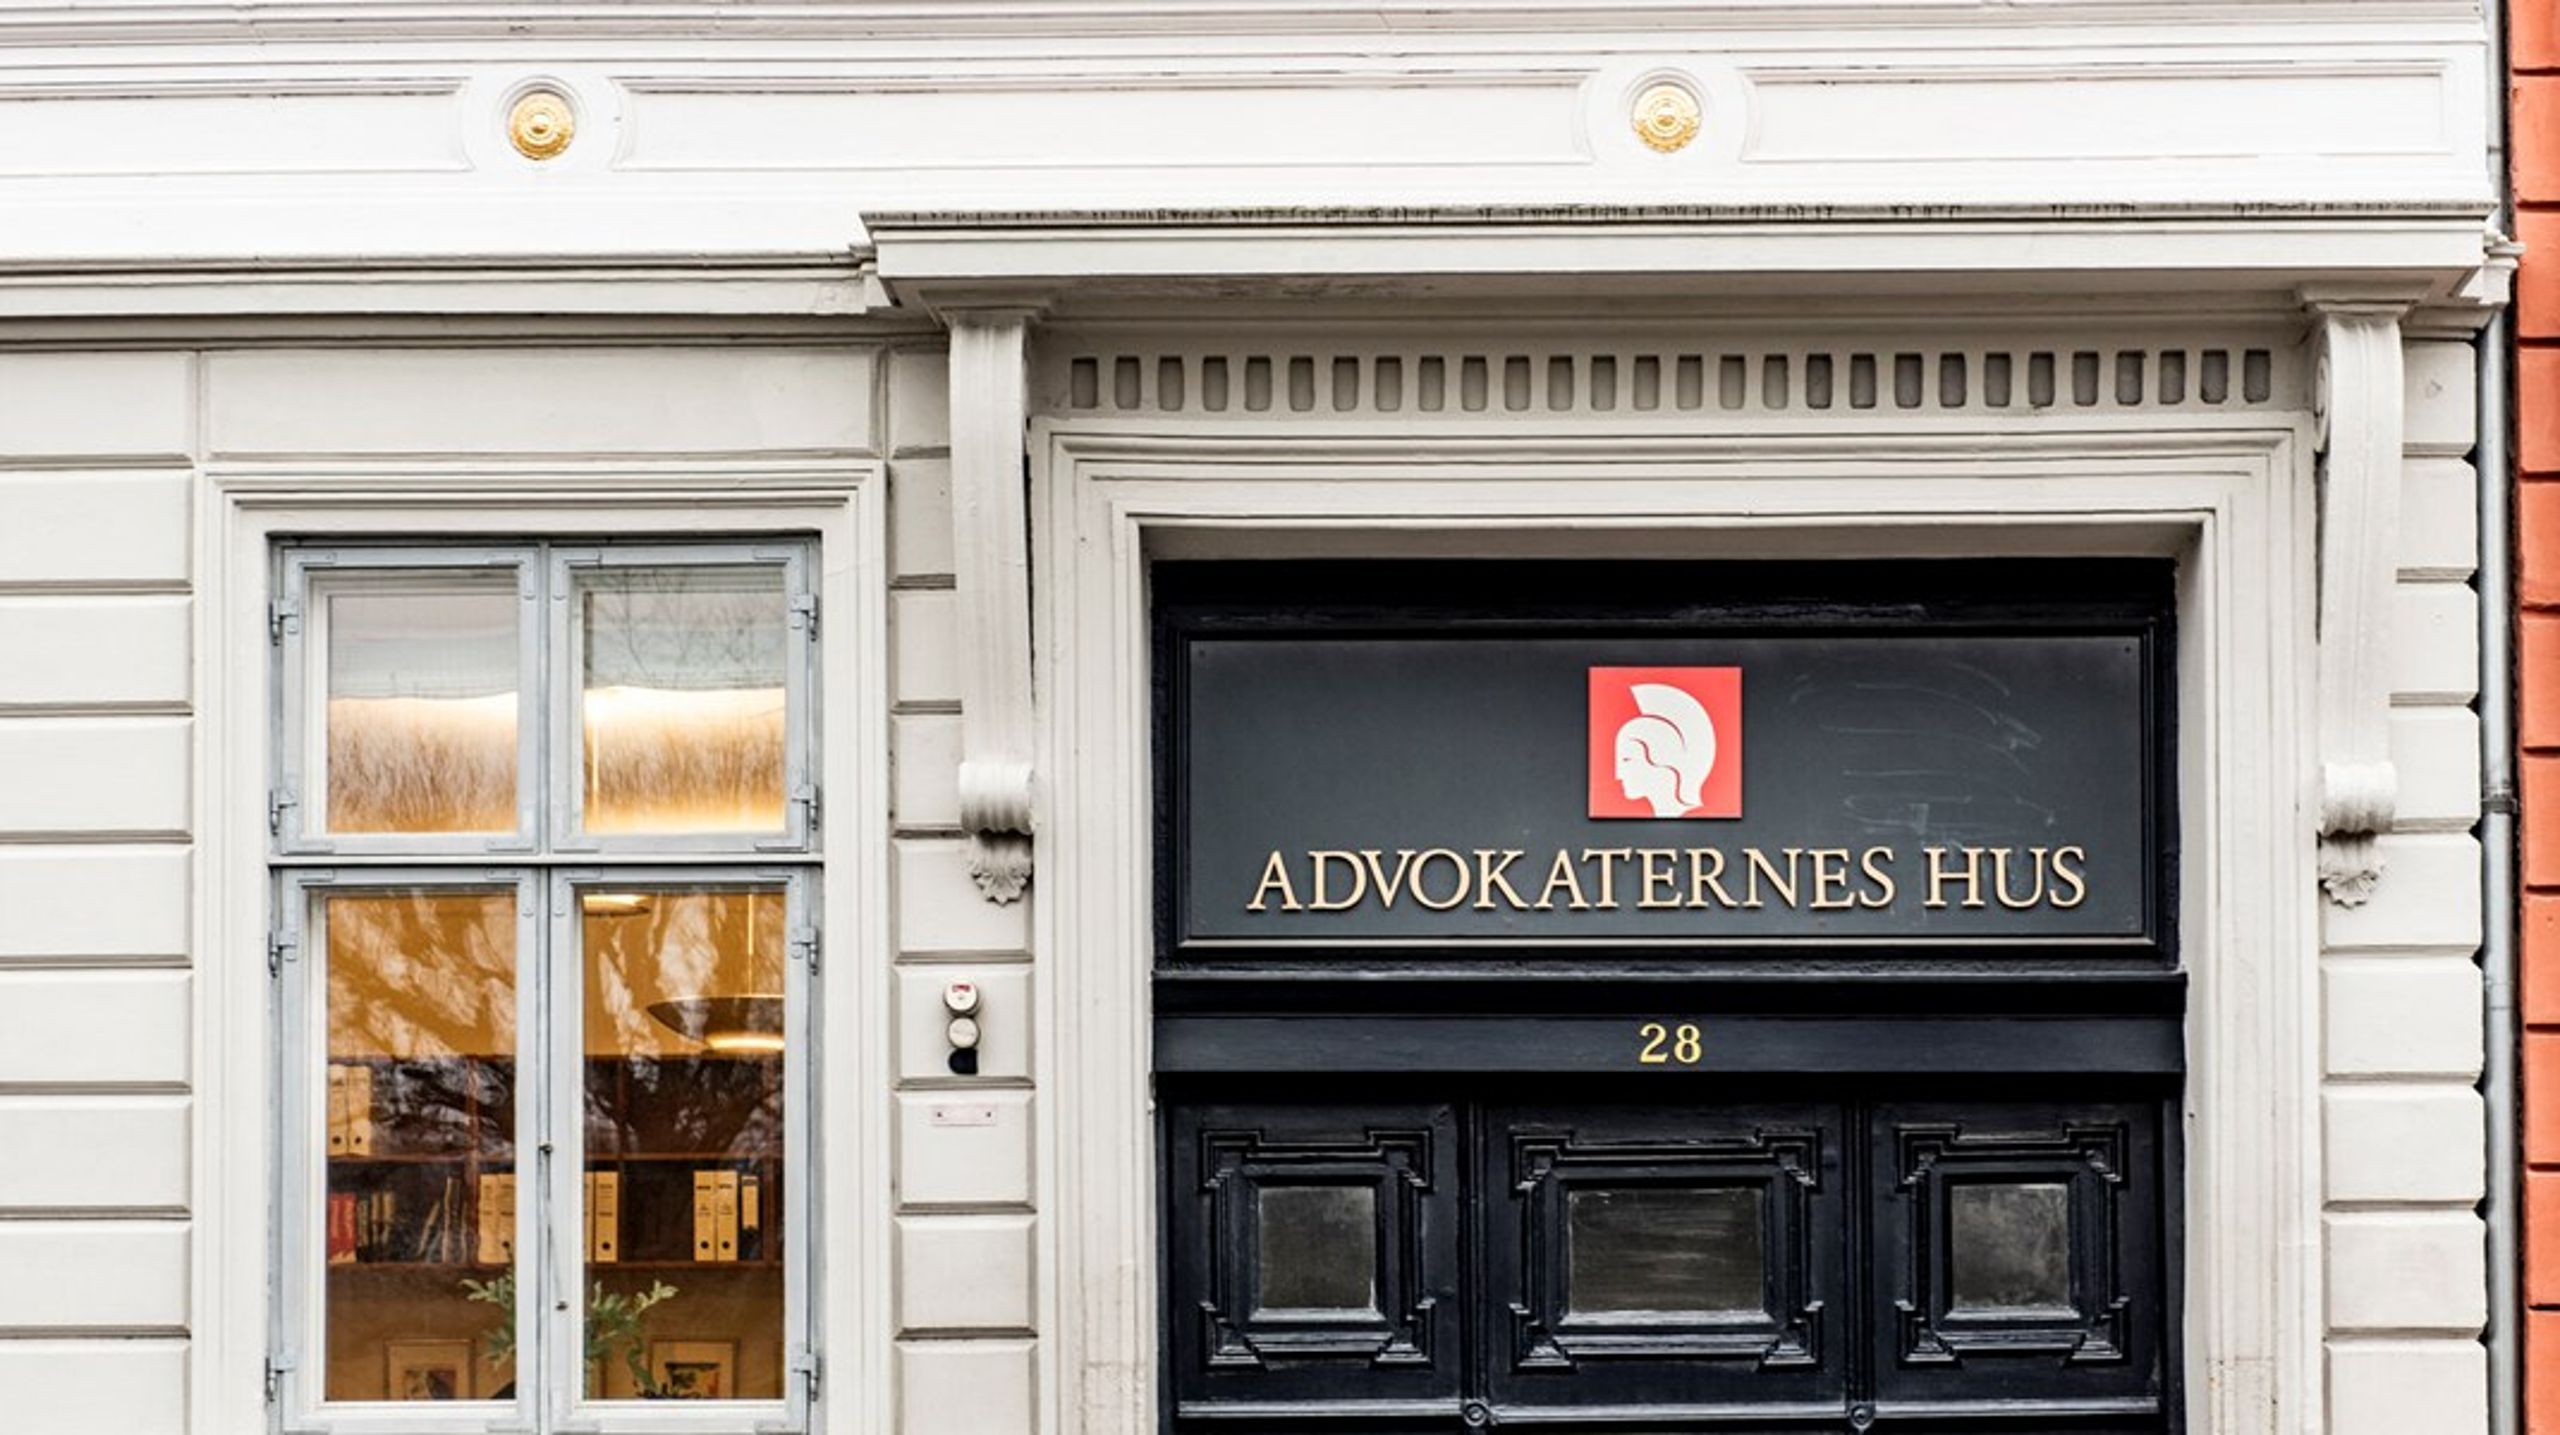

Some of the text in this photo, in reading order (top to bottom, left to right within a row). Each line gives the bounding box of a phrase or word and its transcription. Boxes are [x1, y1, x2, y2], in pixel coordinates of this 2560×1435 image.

[1246, 846, 2086, 910] ADVOKATERNES HUS
[1639, 1023, 1702, 1063] 28
